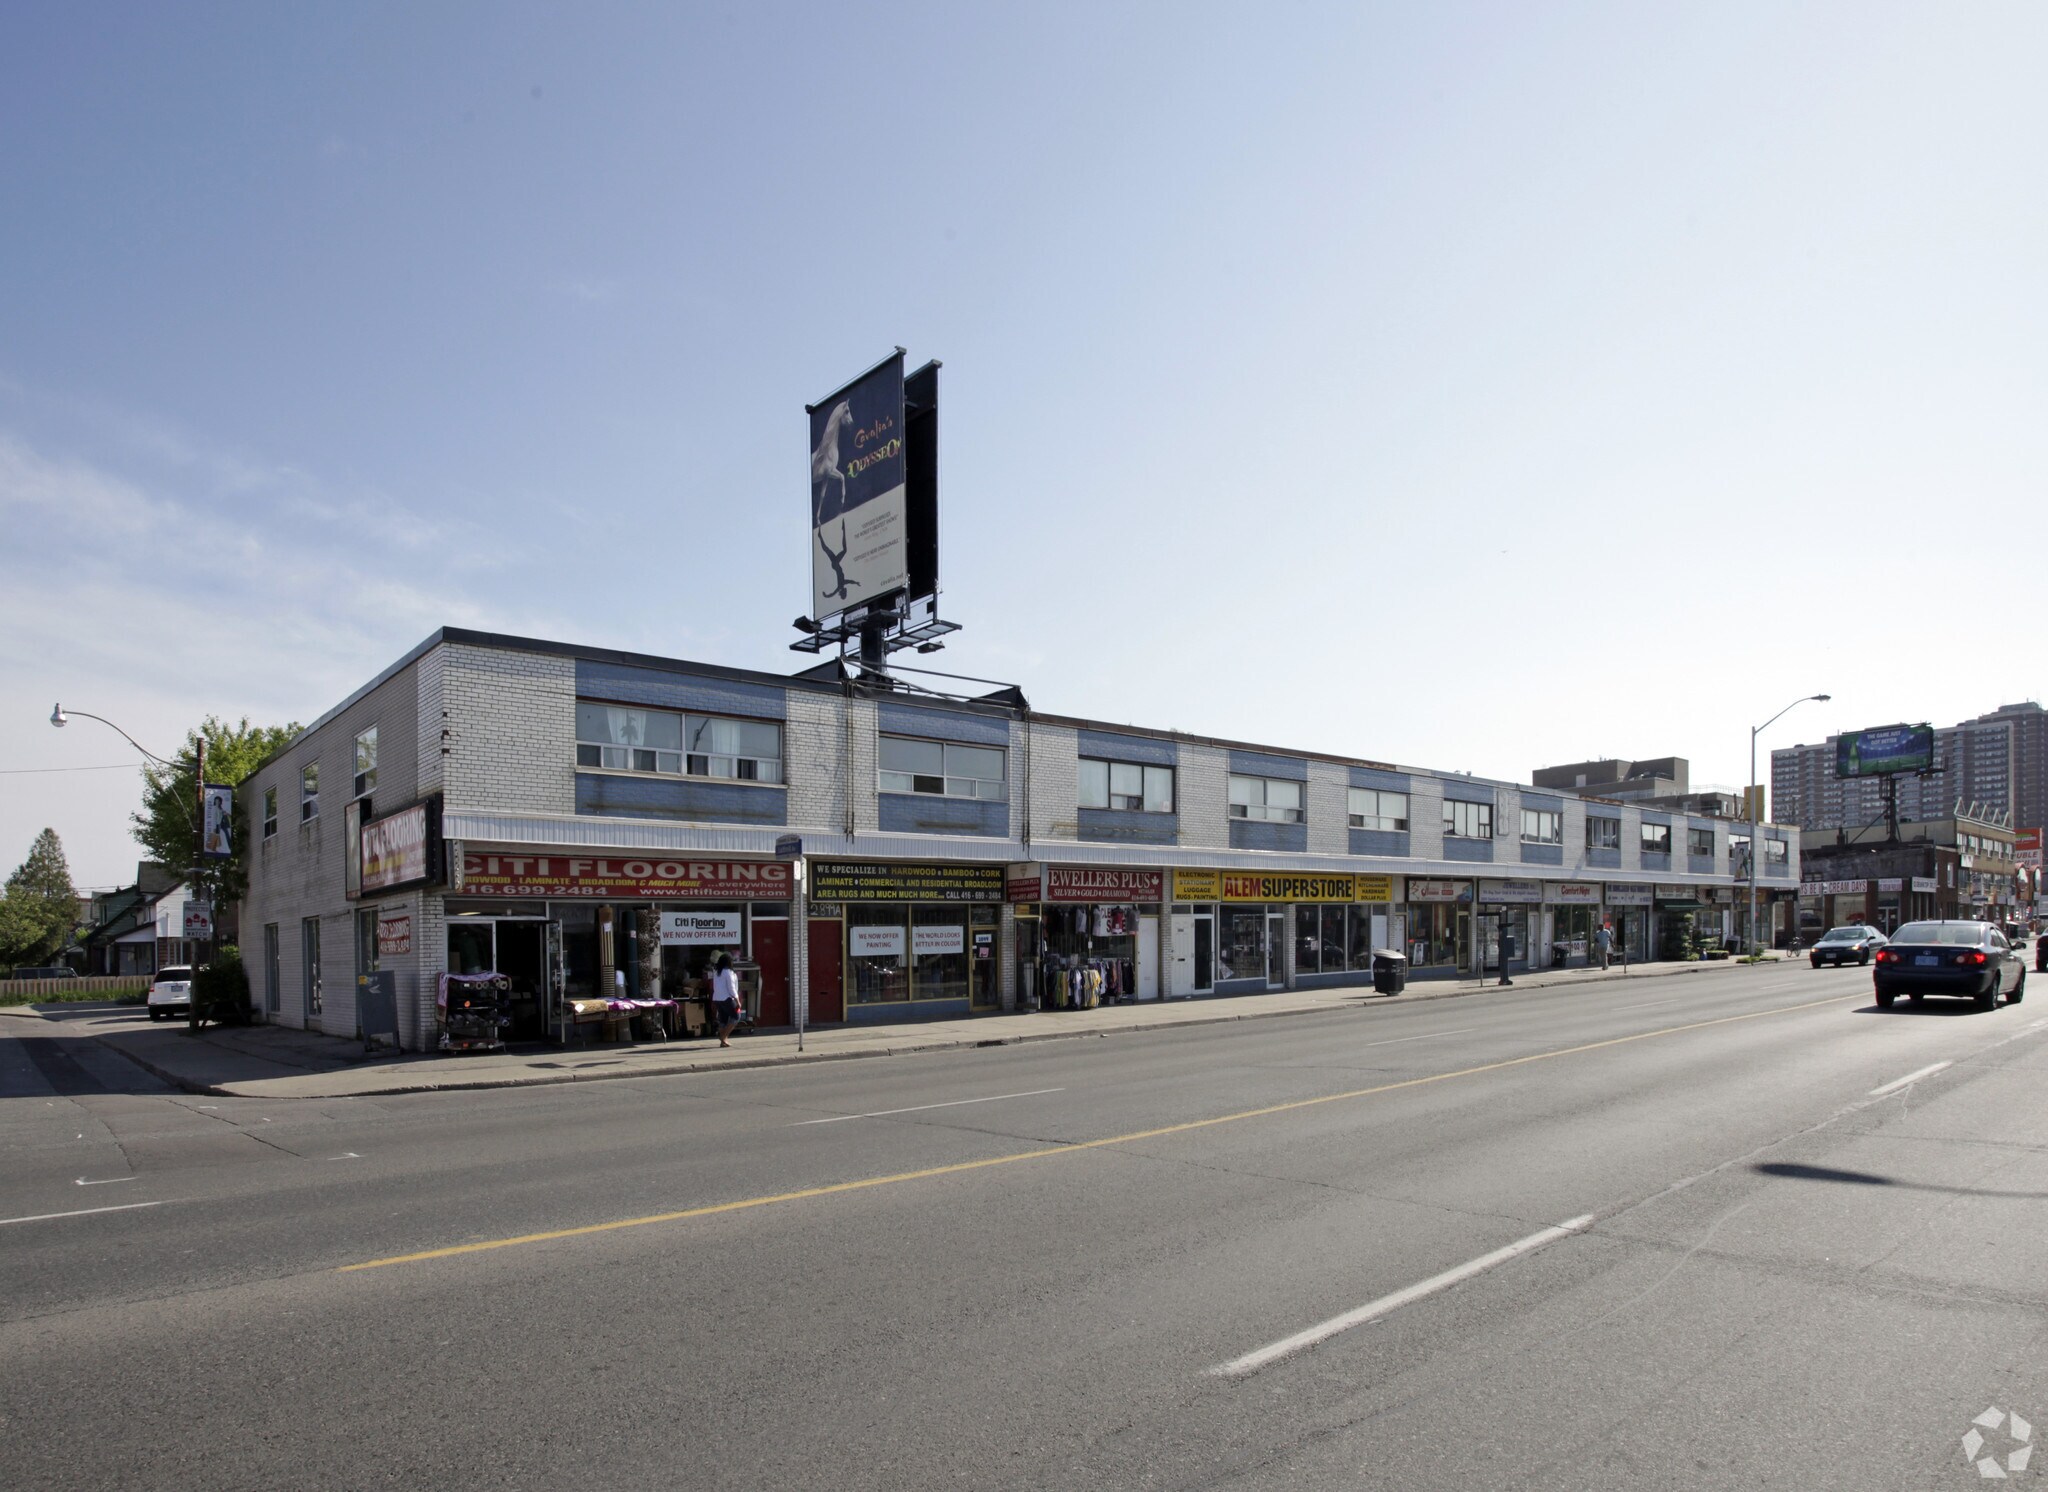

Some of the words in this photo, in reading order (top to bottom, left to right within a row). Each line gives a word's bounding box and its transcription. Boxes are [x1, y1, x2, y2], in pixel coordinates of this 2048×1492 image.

[854, 415, 893, 449] Cavalia's
[2016, 851, 2038, 859] UBLE
[462, 855, 549, 876] CITI
[569, 859, 787, 881] FLOORING
[817, 864, 829, 873] WE
[831, 865, 876, 874] SPECIALIZE
[878, 867, 887, 875] IN
[891, 867, 936, 876] HARDWOOD
[943, 868, 975, 877] BAMBOO
[981, 869, 1000, 877] CORK
[464, 876, 511, 884] RDWOOD
[519, 877, 571, 885] LAMINATE
[579, 878, 636, 886] BROADLOOM
[648, 879, 675, 887] MUCH
[676, 880, 702, 888] MORE
[816, 877, 854, 886] LAMINATE
[860, 878, 905, 887] COMMERCIAL
[906, 879, 919, 887] AND
[921, 880, 963, 888] RESIDENTIAL
[964, 880, 1002, 888] BROADLOOM
[1121, 872, 1150, 889] PLUS
[1828, 880, 1850, 894] CREAM
[1851, 879, 1867, 893] DAYS
[465, 884, 608, 895] 16.699.2484
[639, 888, 787, 898] www.citiflooring.com
[816, 889, 837, 898] AREA
[838, 889, 859, 898] RUGS
[860, 890, 875, 898] AND
[876, 890, 897, 899] MUCH
[899, 890, 918, 899] MUCH
[945, 891, 960, 899] CALL
[1054, 888, 1077, 897] SILVER
[1081, 889, 1098, 897] GOLD
[1102, 889, 1131, 898] DIAMOND
[674, 917, 689, 927] Citi
[690, 917, 726, 929] Flooring
